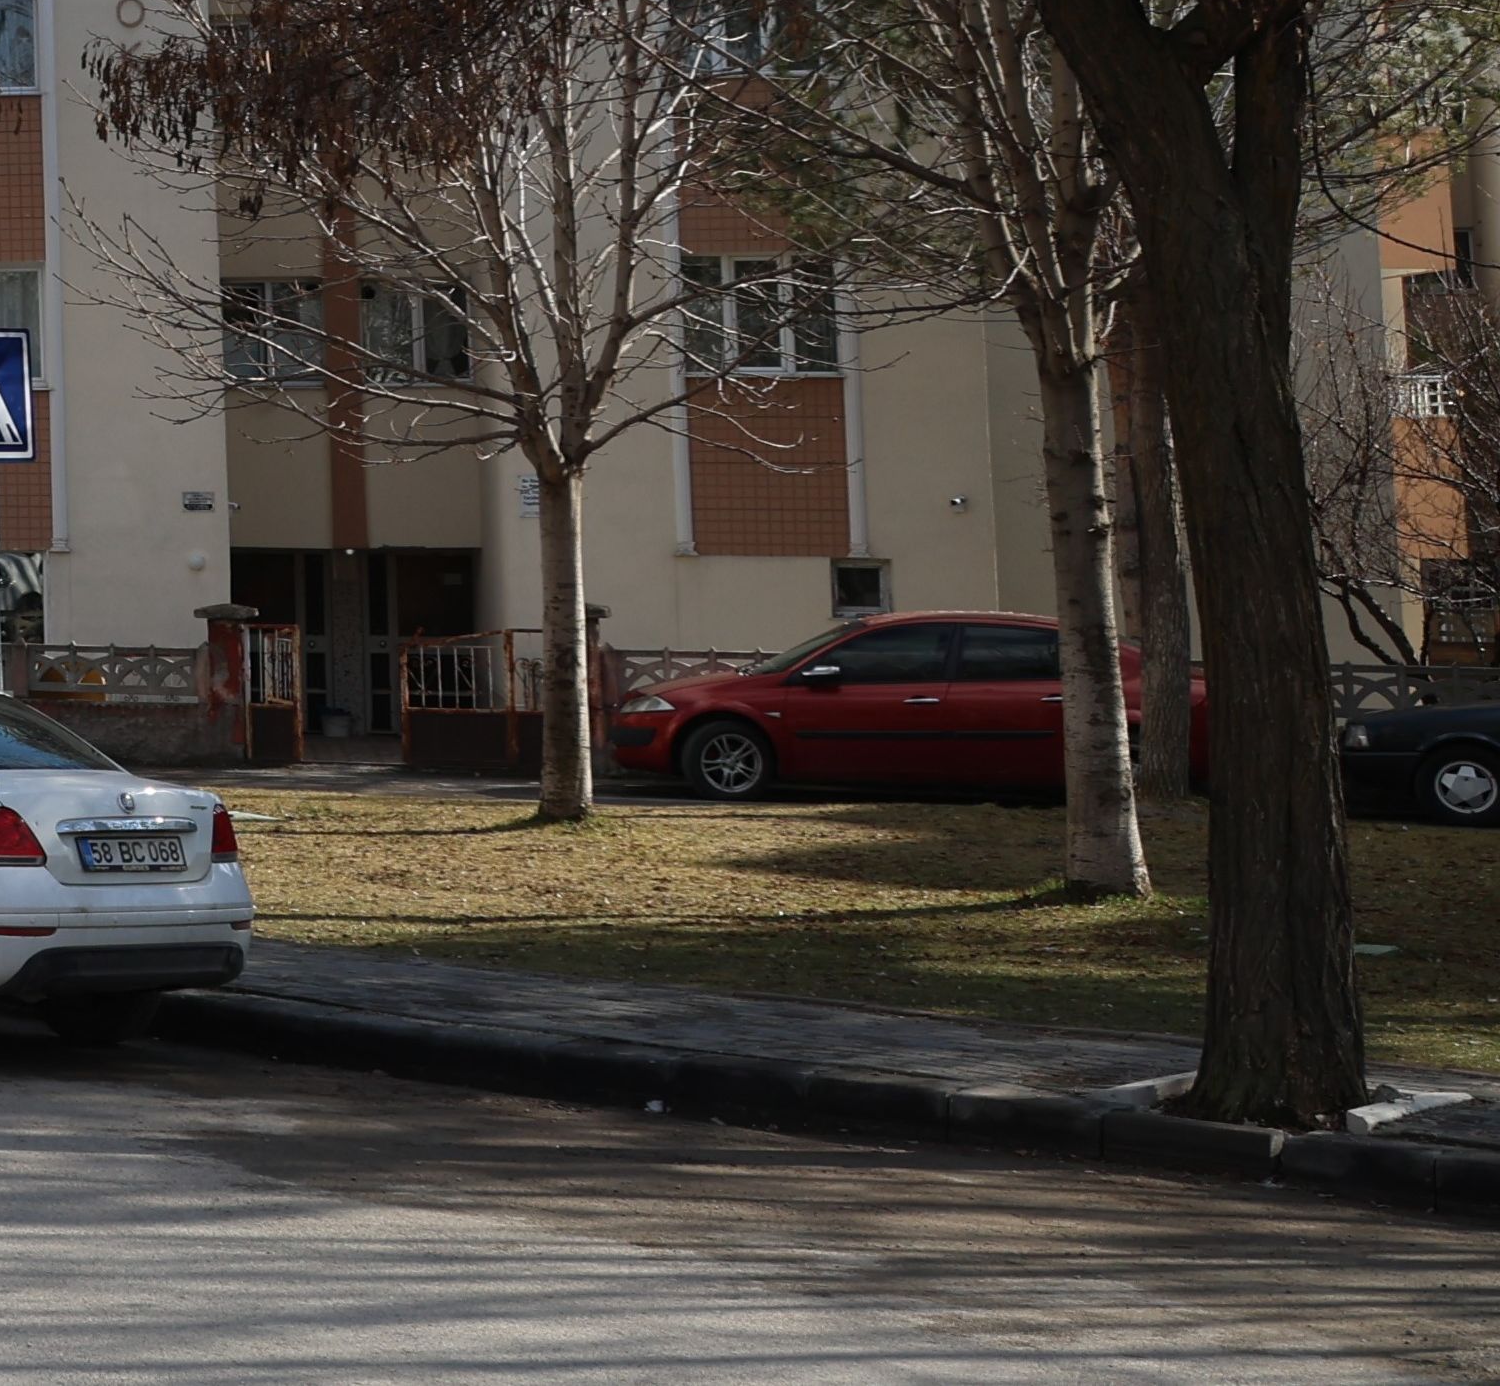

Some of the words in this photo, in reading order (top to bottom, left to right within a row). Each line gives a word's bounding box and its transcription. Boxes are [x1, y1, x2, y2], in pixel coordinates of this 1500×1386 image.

[91, 842, 113, 863] 58
[118, 841, 145, 863] BC
[149, 841, 180, 863] 068
